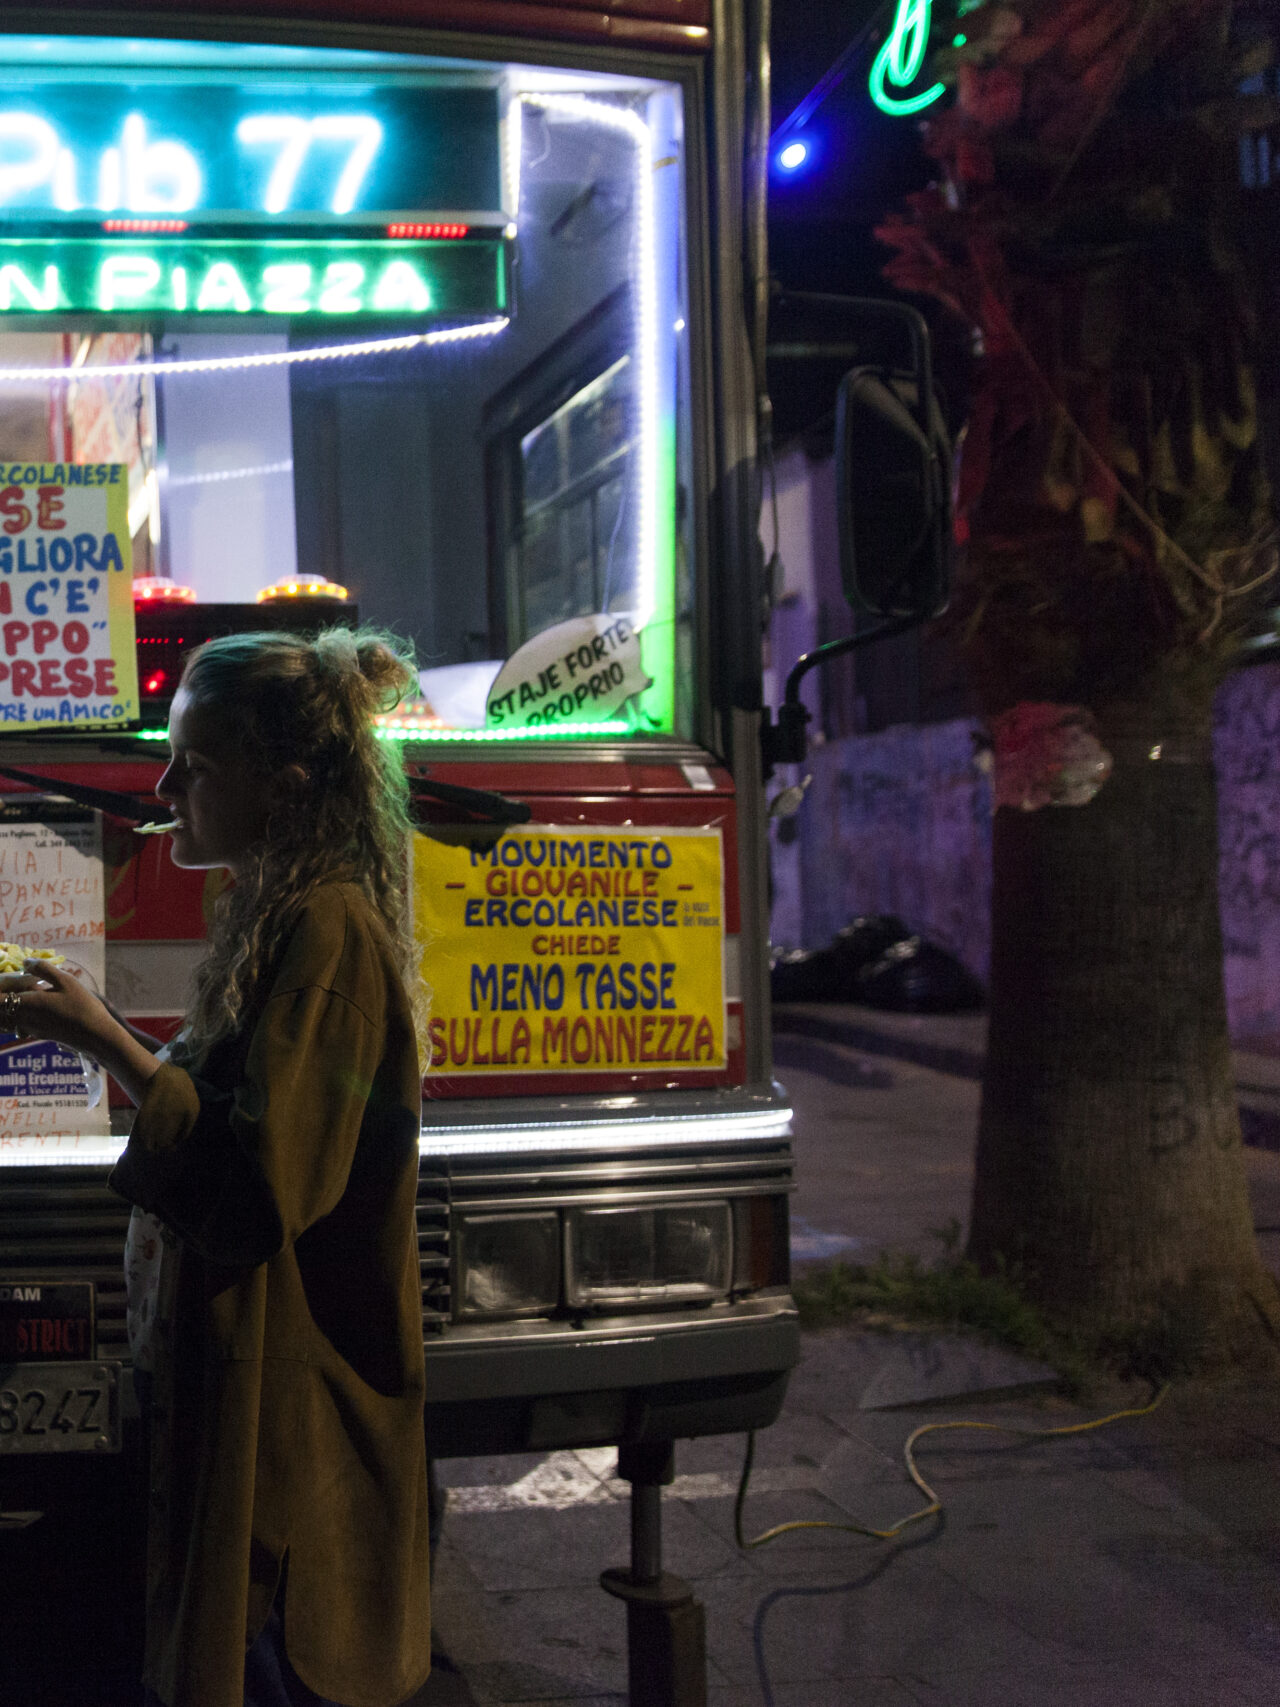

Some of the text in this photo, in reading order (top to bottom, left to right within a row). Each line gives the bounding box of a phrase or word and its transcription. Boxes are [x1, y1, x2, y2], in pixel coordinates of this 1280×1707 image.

[237, 115, 383, 214] 77
[99, 259, 433, 314] PIAZZA
[25, 577, 100, 616] C'E'
[489, 618, 628, 724] STAJE FORTE
[526, 662, 624, 726] PROPRIO
[470, 839, 672, 868] MOVIMENTO
[486, 869, 658, 897] GIOVANILE
[3, 900, 74, 929] VERDI
[465, 898, 678, 926] ERCOLANESE
[532, 935, 621, 955] CHIEDE
[470, 962, 676, 1011] MENO TASSE
[428, 1014, 714, 1066] SULLA MONNEZZA
[8, 1054, 81, 1071] Luigi Rea
[28, 1071, 86, 1085] Ercolanes
